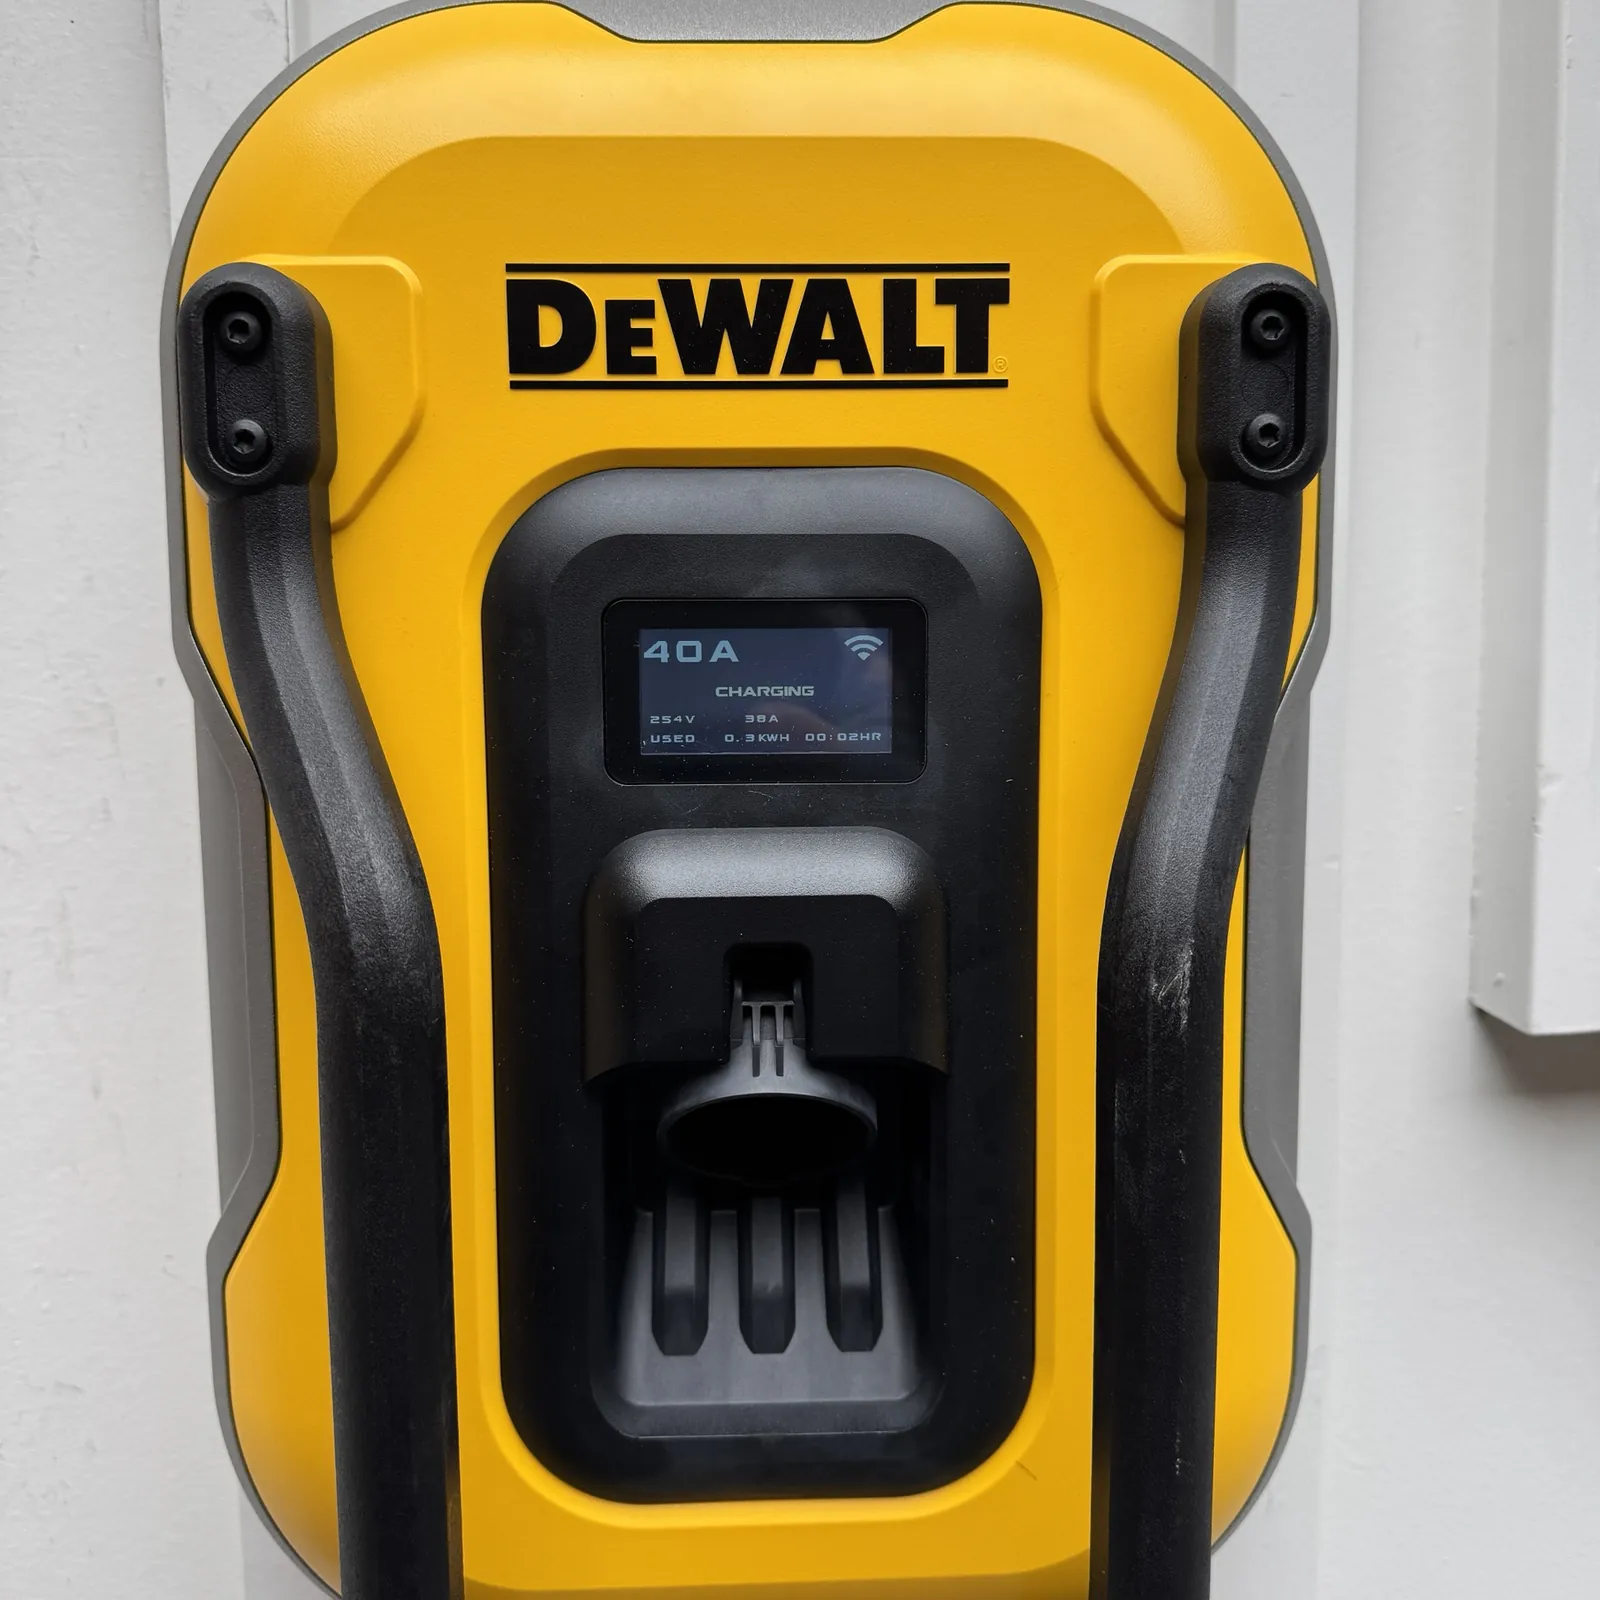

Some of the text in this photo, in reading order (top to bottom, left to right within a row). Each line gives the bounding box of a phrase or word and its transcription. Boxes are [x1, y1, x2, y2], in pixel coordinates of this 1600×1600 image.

[506, 278, 1010, 375] DEWALT
[643, 640, 740, 663] 40A
[715, 685, 815, 698] CHARGING
[650, 714, 779, 724] 254V 38A
[650, 734, 696, 744] USED
[805, 731, 882, 742] 00:02HR
